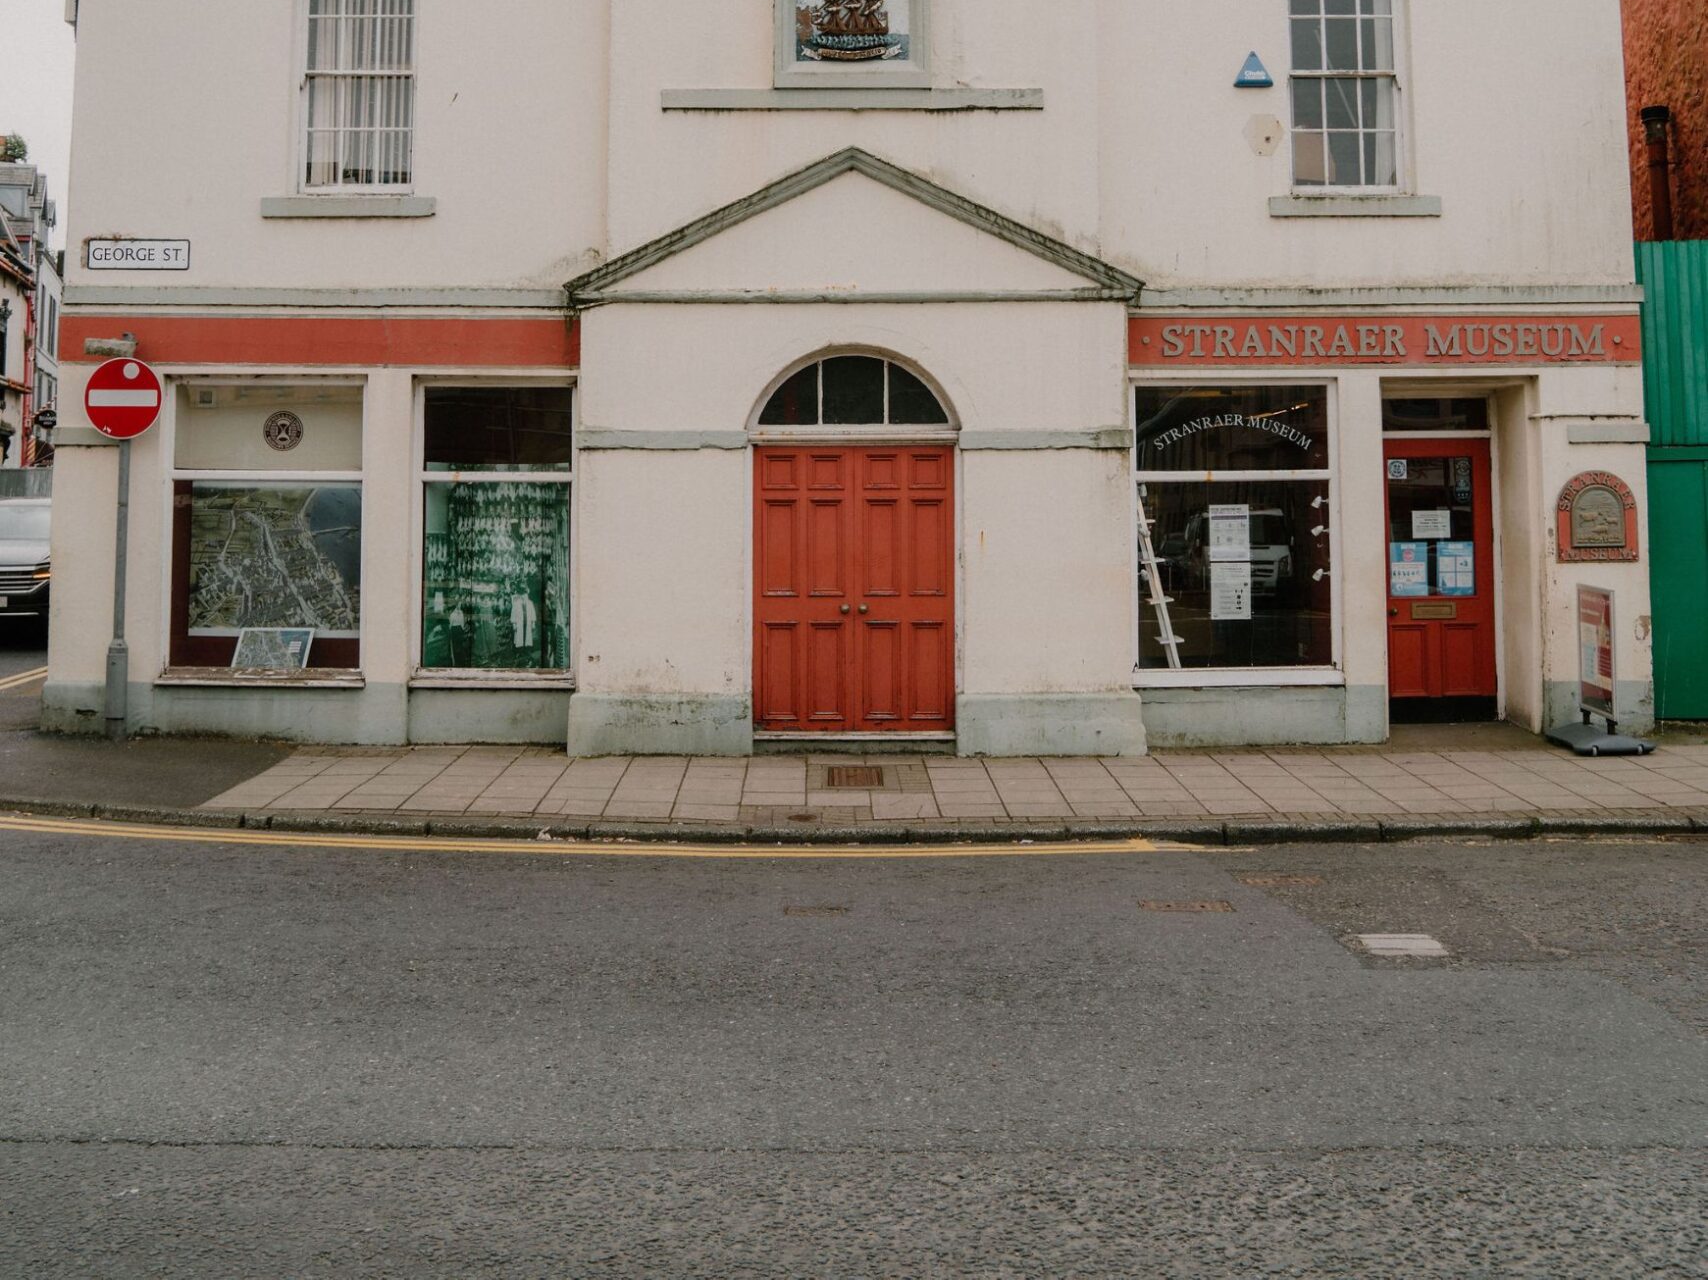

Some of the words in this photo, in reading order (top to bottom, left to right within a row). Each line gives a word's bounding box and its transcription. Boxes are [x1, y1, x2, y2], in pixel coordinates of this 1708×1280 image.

[92, 247, 155, 261] GEORGE
[163, 248, 186, 261] ST.
[1162, 324, 1408, 357] STRANRAER
[1424, 323, 1605, 357] MUSEUM
[1153, 413, 1244, 451] STRANRAER
[1247, 415, 1313, 451] MUSEUM
[1568, 548, 1633, 559] MUSEUM
